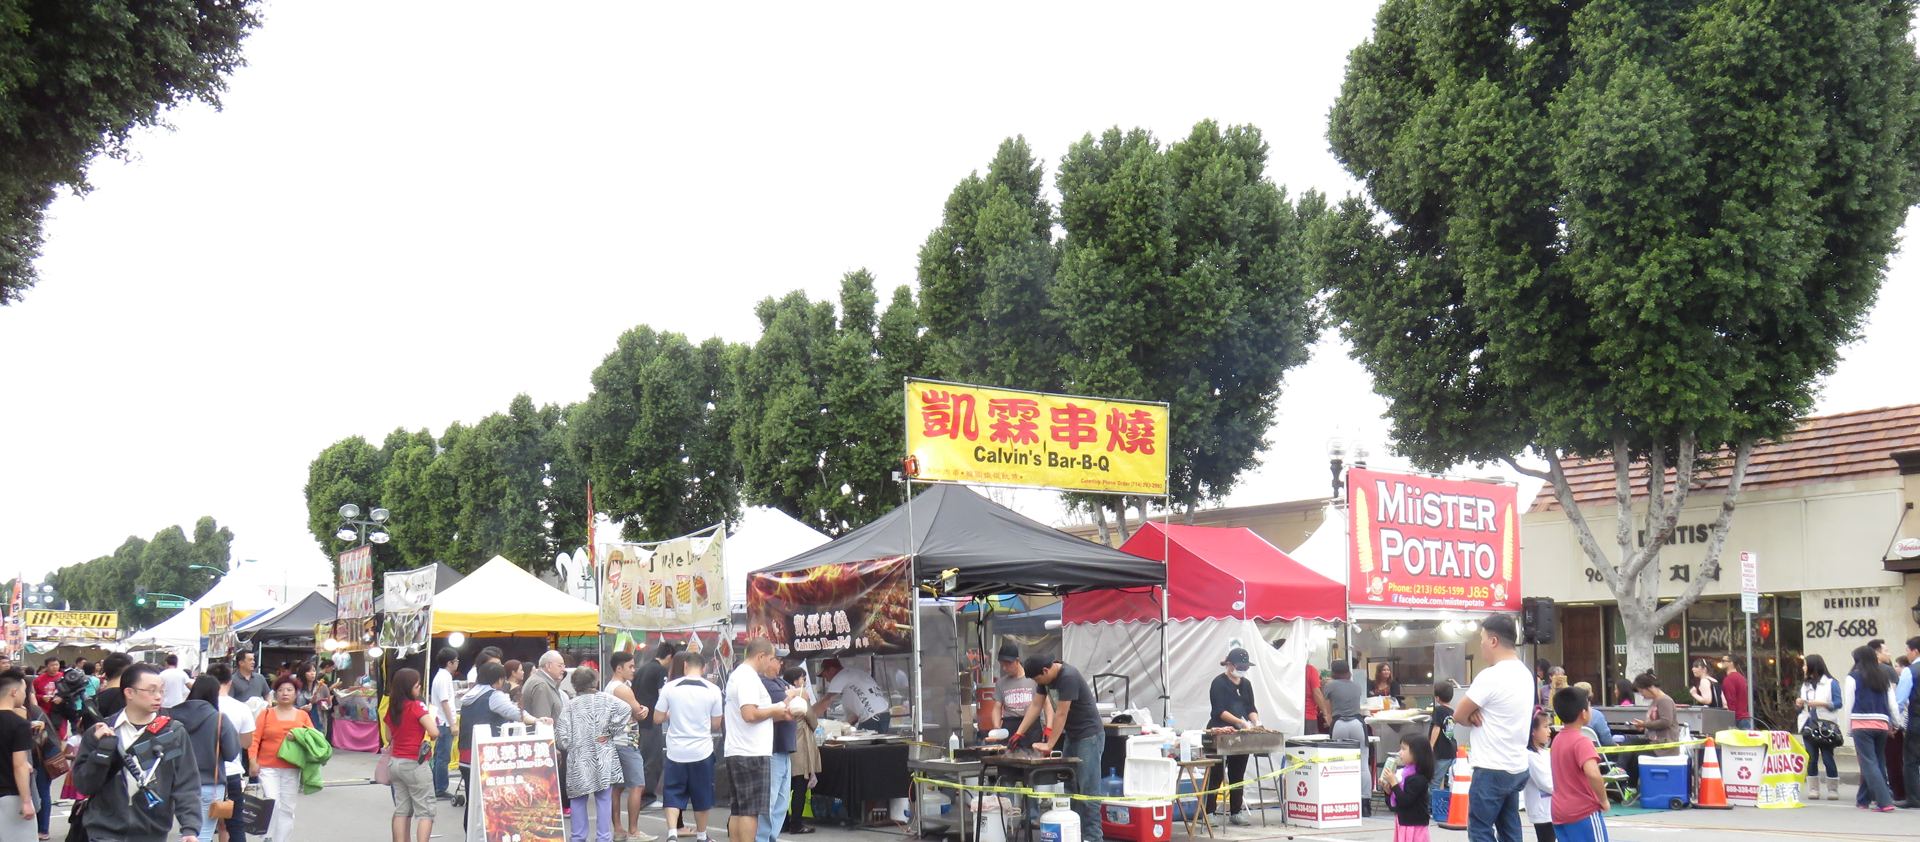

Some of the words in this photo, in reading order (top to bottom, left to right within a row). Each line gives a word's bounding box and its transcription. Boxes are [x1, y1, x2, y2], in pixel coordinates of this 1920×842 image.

[921, 389, 1155, 455] 凱霖串燒
[973, 445, 1042, 467] Calvin's
[1047, 451, 1110, 473] Bar-B-Q
[1638, 523, 1718, 548] DNTIS
[1379, 527, 1497, 580] POTATO
[1388, 582, 1412, 593] Phone:
[1413, 584, 1432, 594] (213)
[1433, 585, 1464, 596] 605-1599
[1467, 586, 1489, 599] J&S
[1824, 596, 1880, 609] DENTISTRY
[1805, 619, 1878, 638] 287-6688
[1653, 643, 1680, 654] TENING
